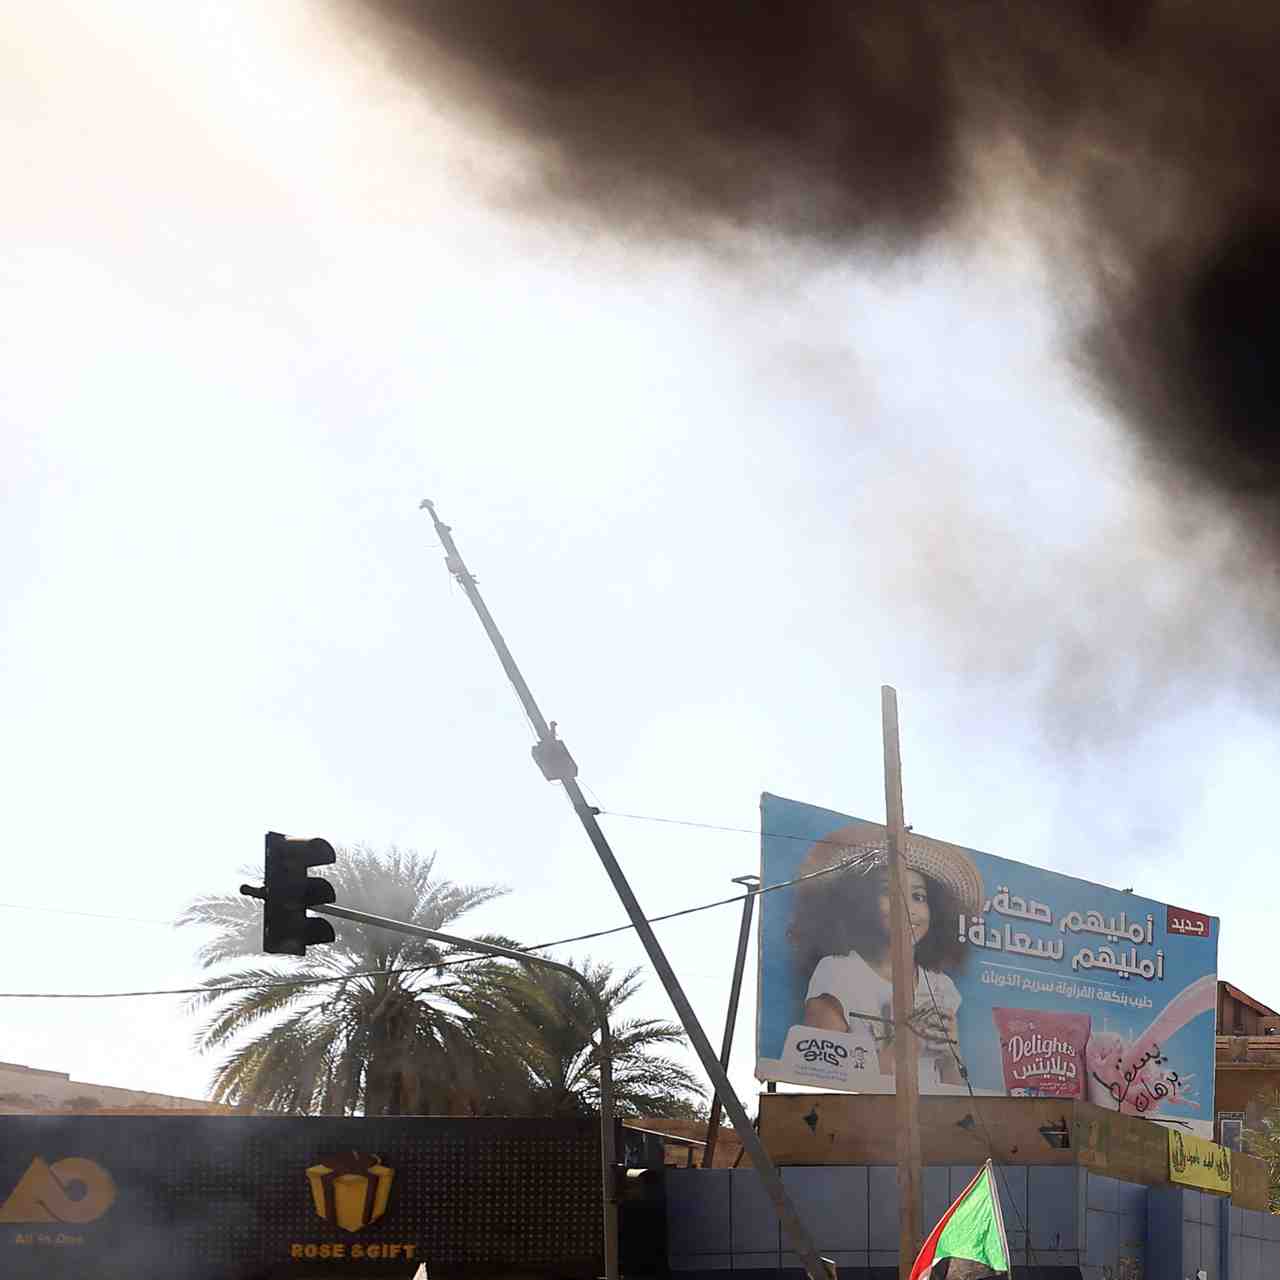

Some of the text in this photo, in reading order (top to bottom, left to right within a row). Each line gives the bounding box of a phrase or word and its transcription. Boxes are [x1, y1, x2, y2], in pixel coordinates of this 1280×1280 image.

[1171, 916, 1205, 933] جديد
[796, 1039, 848, 1059] CAPO
[804, 1050, 840, 1066] كابو
[1008, 1034, 1076, 1063] Delights
[1012, 1057, 1076, 1081] ديلايتس
[1135, 1071, 1182, 1112] برهان
[290, 1242, 345, 1258] ROSE
